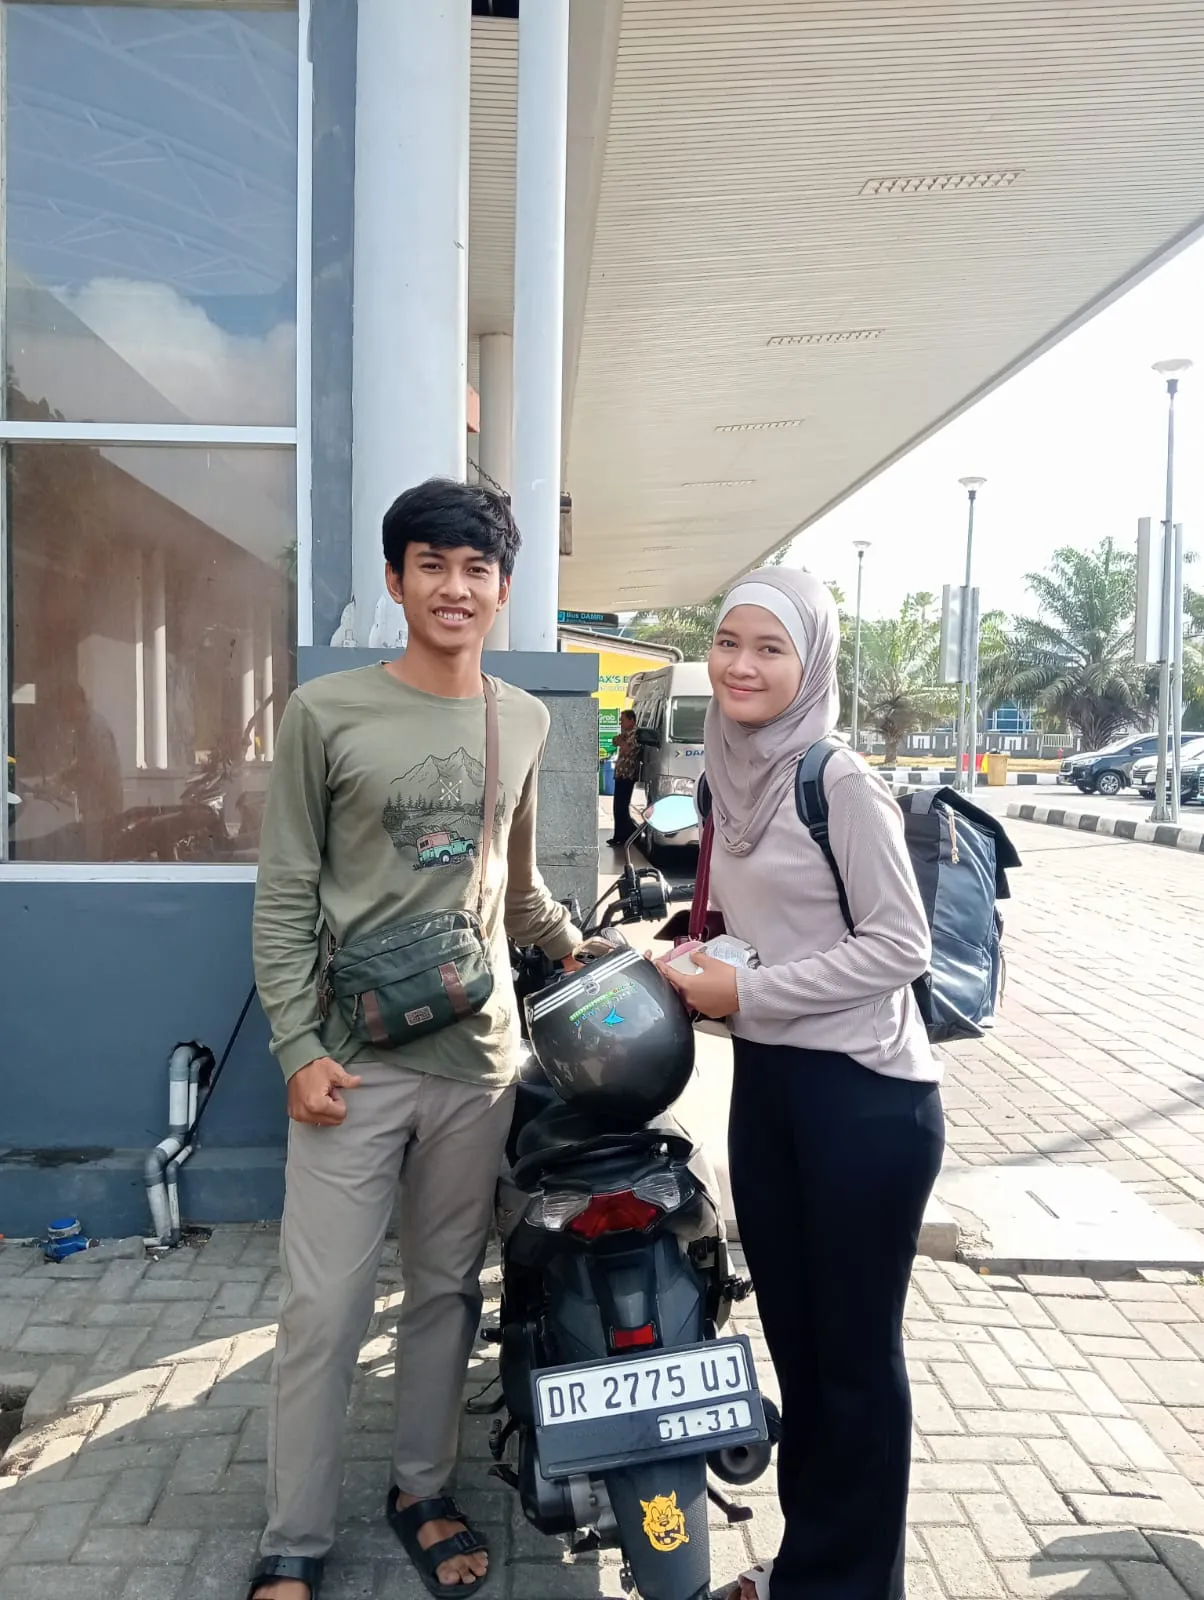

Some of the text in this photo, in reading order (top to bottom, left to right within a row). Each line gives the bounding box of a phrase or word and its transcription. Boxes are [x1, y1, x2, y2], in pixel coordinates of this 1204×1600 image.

[548, 1356, 741, 1417] DR 2775 UJ
